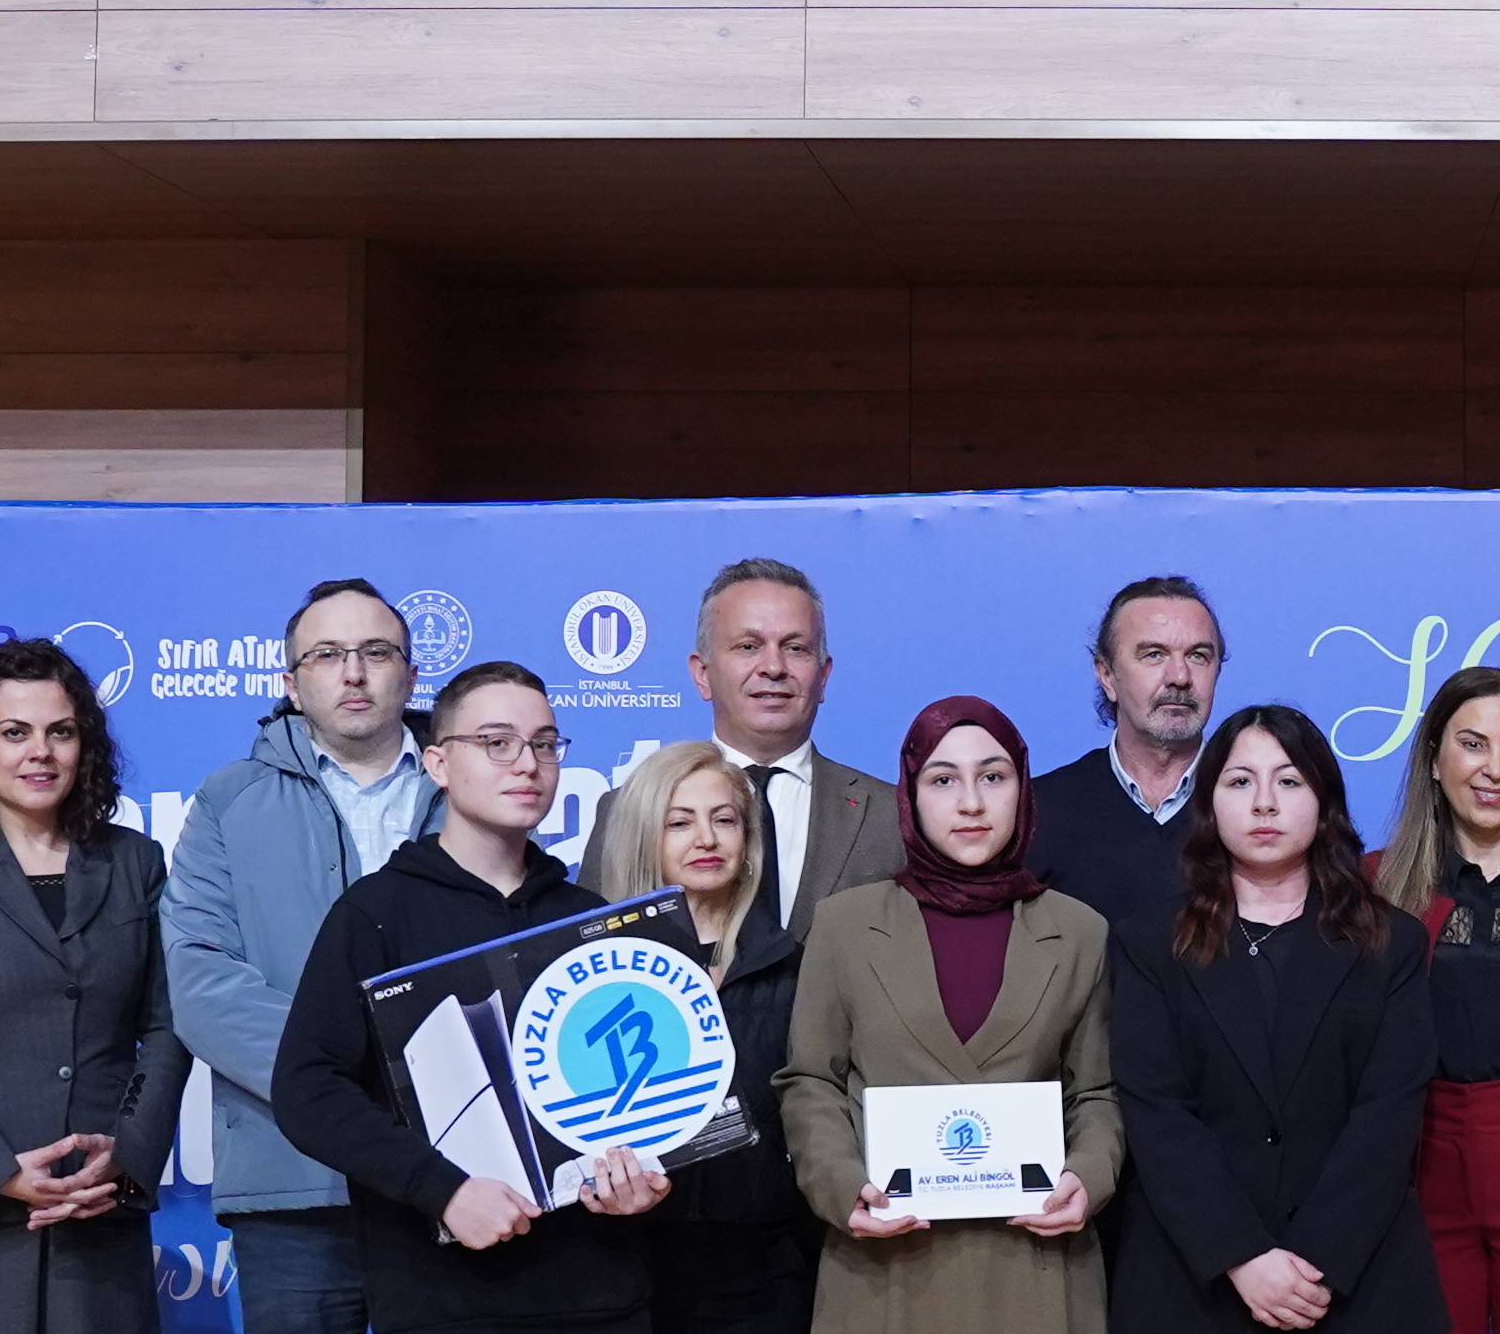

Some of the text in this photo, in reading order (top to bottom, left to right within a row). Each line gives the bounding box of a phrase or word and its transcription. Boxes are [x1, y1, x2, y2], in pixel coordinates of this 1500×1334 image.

[581, 593, 611, 611] OKAN
[158, 638, 219, 669] SIFIR
[579, 679, 632, 690] İSTANBUL
[582, 692, 681, 708] ÜNİVERSİTESİ
[374, 981, 414, 1001] SONY
[524, 987, 568, 1091] TUZLA
[936, 1115, 951, 1144] TUZLA
[918, 1169, 1016, 1185] AV. EREN ALİ BİNGÖL
